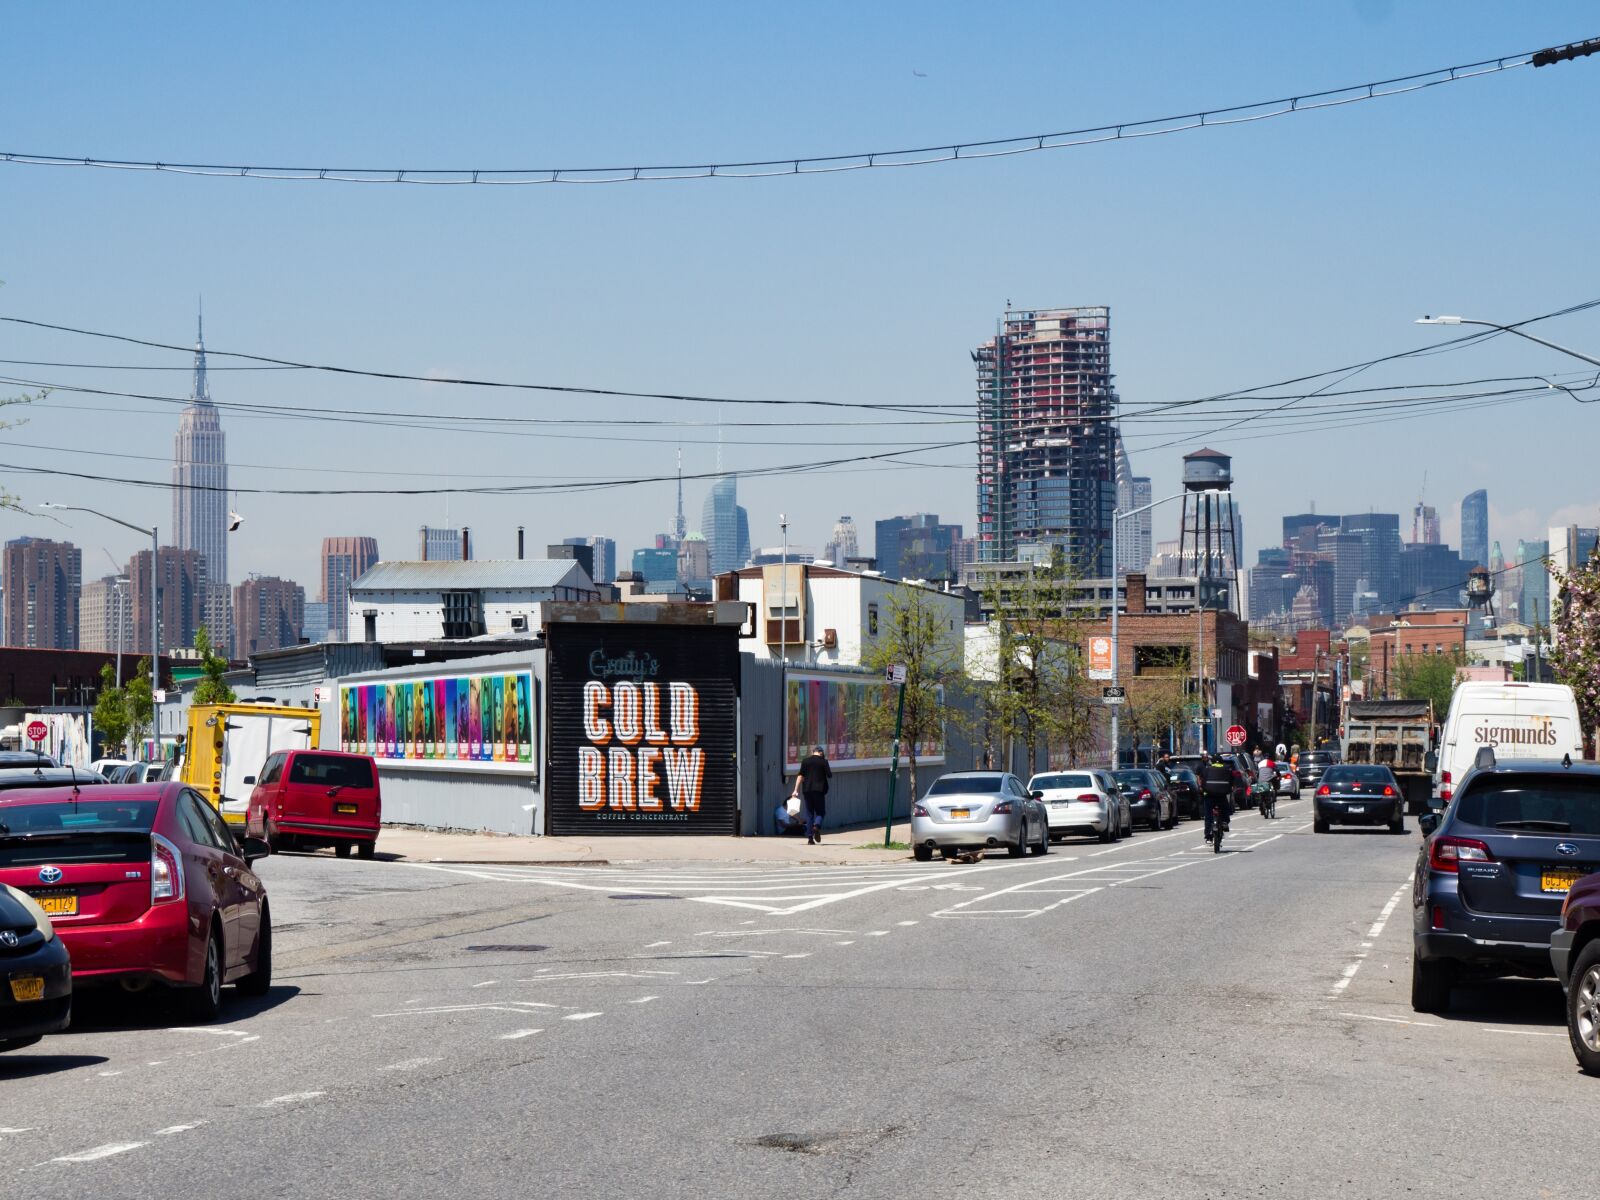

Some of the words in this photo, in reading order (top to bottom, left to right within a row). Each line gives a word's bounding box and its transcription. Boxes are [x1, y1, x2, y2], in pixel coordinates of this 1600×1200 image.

[583, 680, 700, 746] COLD
[28, 726, 47, 735] STOP
[1227, 731, 1245, 740] STOP
[1474, 719, 1557, 748] sigmund's
[578, 746, 706, 812] BREW
[630, 813, 688, 821] CONCENTRATE
